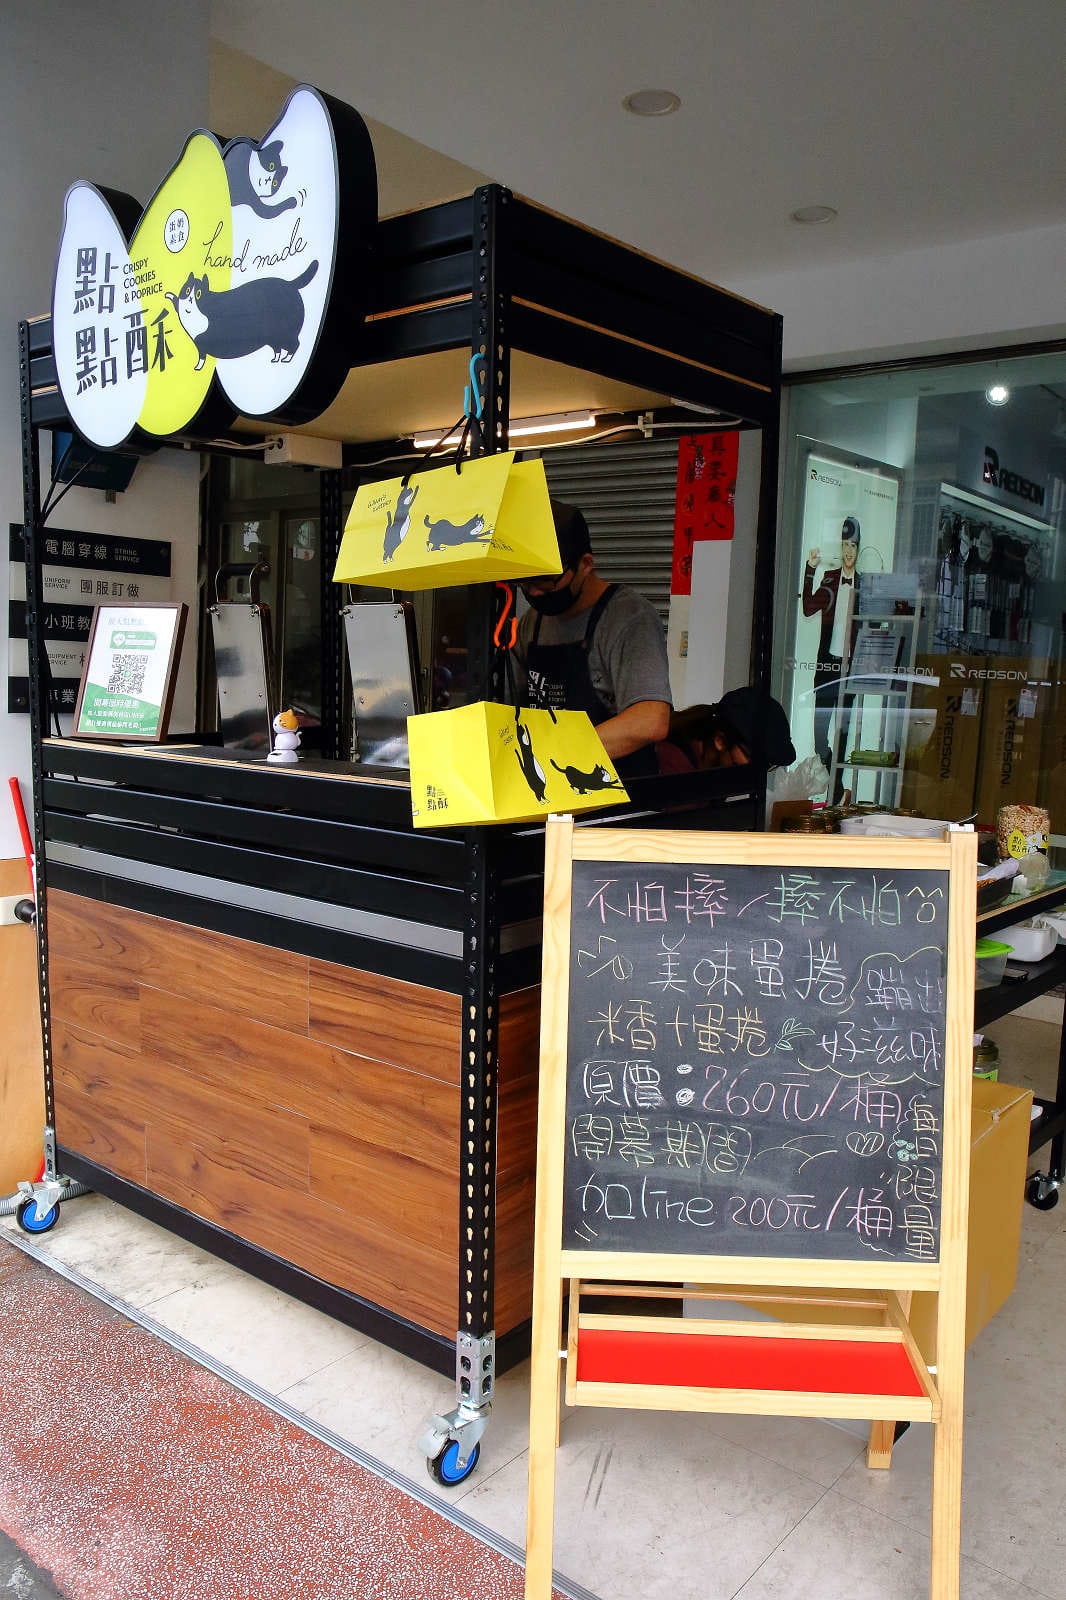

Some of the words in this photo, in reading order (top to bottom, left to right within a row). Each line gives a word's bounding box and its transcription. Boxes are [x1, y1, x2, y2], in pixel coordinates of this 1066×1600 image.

[203, 220, 250, 272] hand
[252, 217, 307, 269] made
[122, 257, 149, 275] CRISPY
[73, 247, 119, 315] 點
[123, 270, 156, 289] COOKIES
[124, 292, 130, 304] &
[131, 282, 163, 302] POPRICE
[75, 308, 174, 396] 點酥
[45, 539, 108, 560] 電腦穿線
[80, 579, 140, 599] 團服訂做
[968, 669, 1028, 681] REDSON
